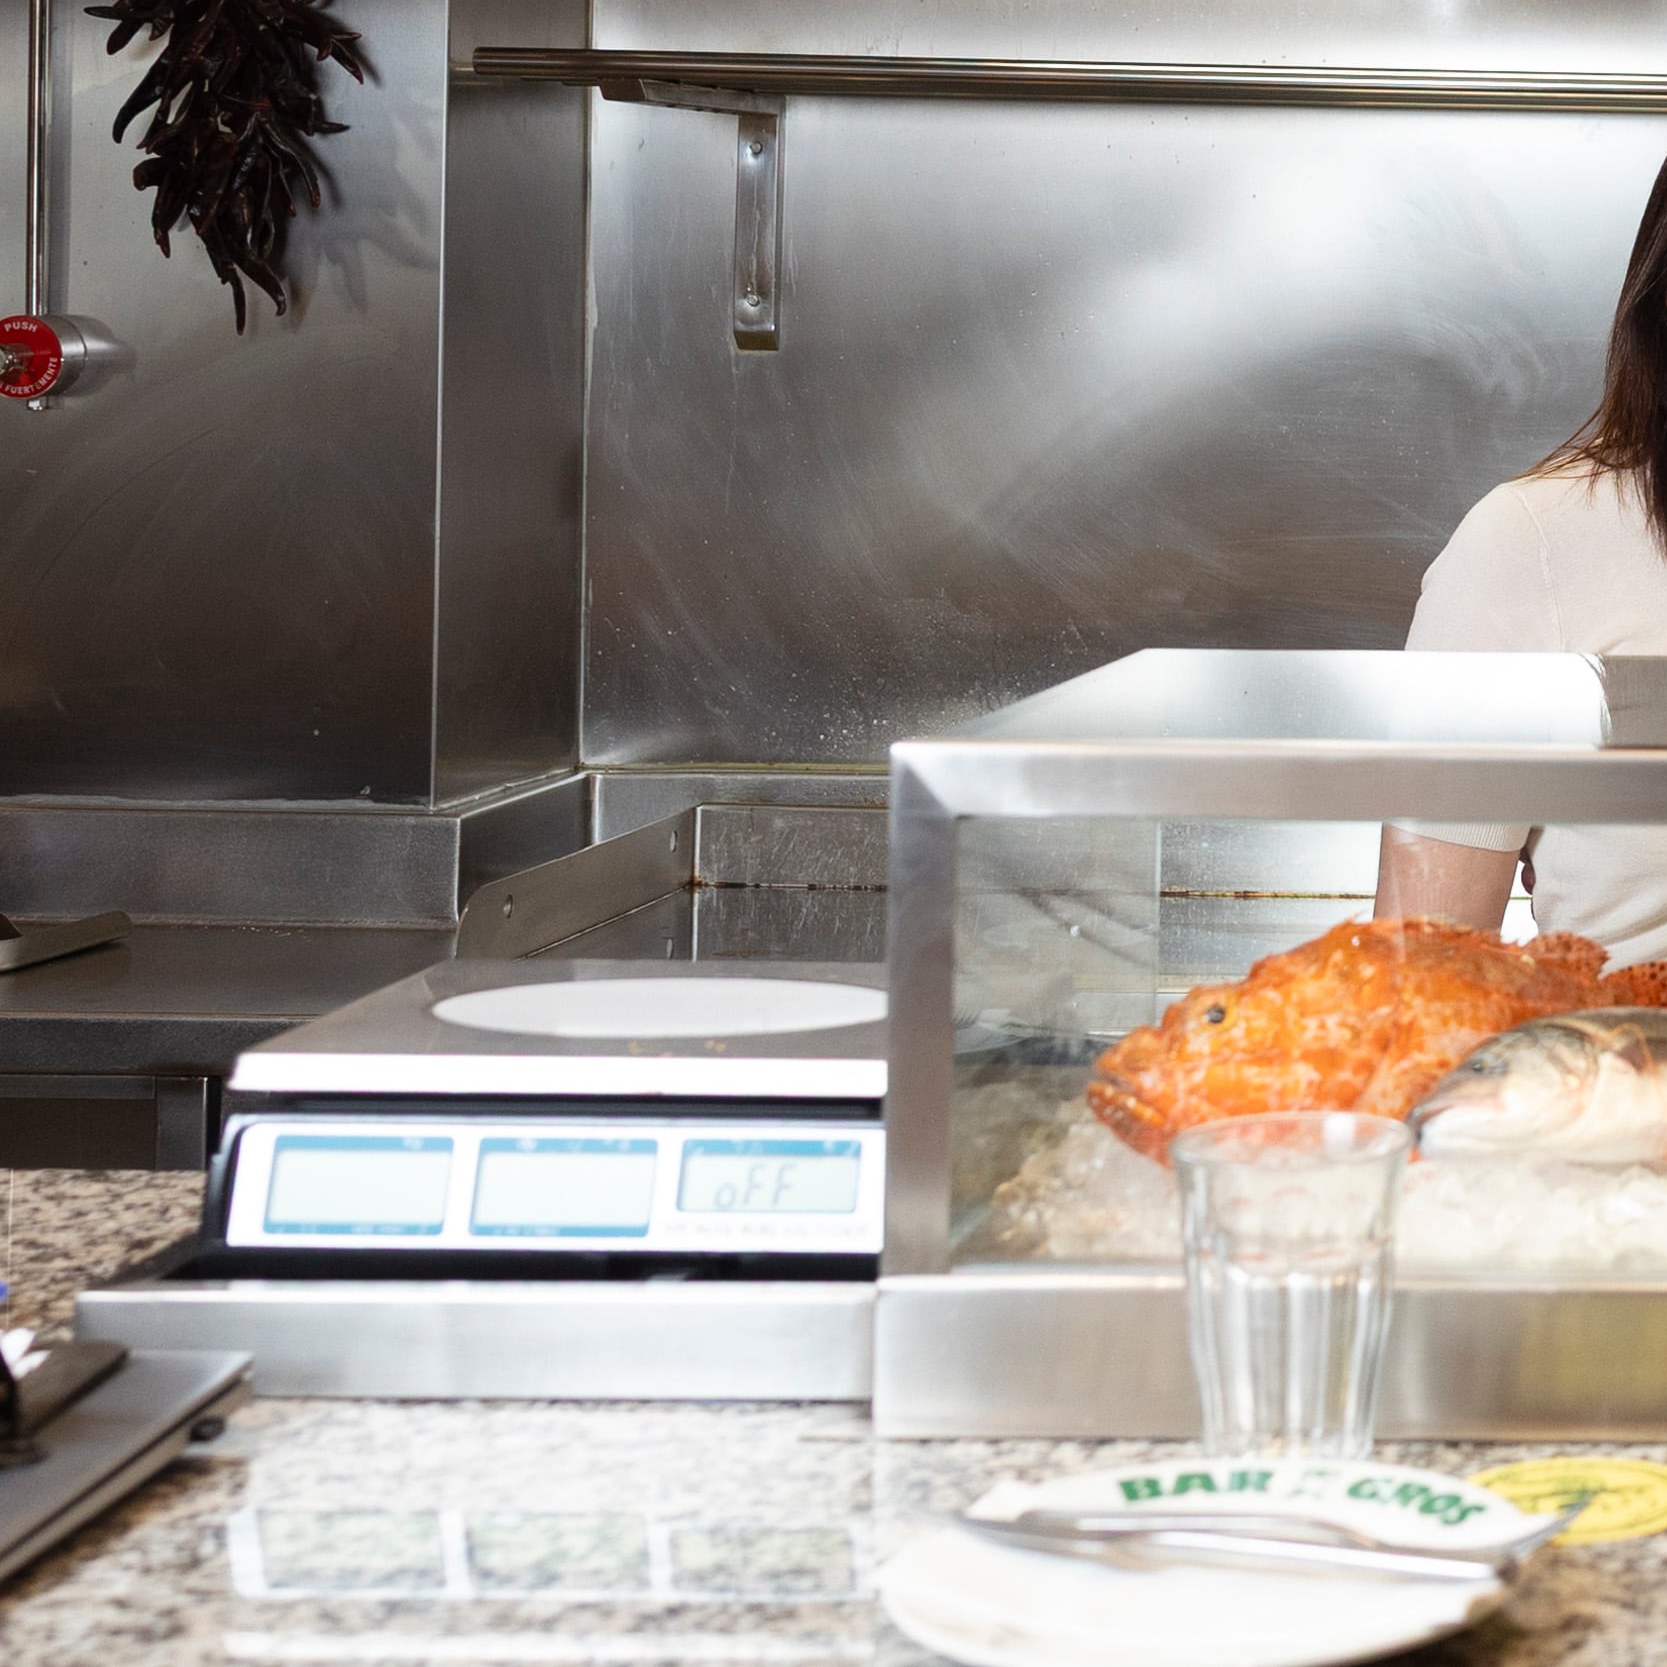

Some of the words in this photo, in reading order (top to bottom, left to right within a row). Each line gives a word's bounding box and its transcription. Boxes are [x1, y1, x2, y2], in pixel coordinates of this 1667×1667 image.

[3, 321, 38, 332] PUSH
[4, 357, 58, 395] FUERTEMENTE
[1118, 1468, 1273, 1504] BAR
[1347, 1476, 1487, 1528] GROS
